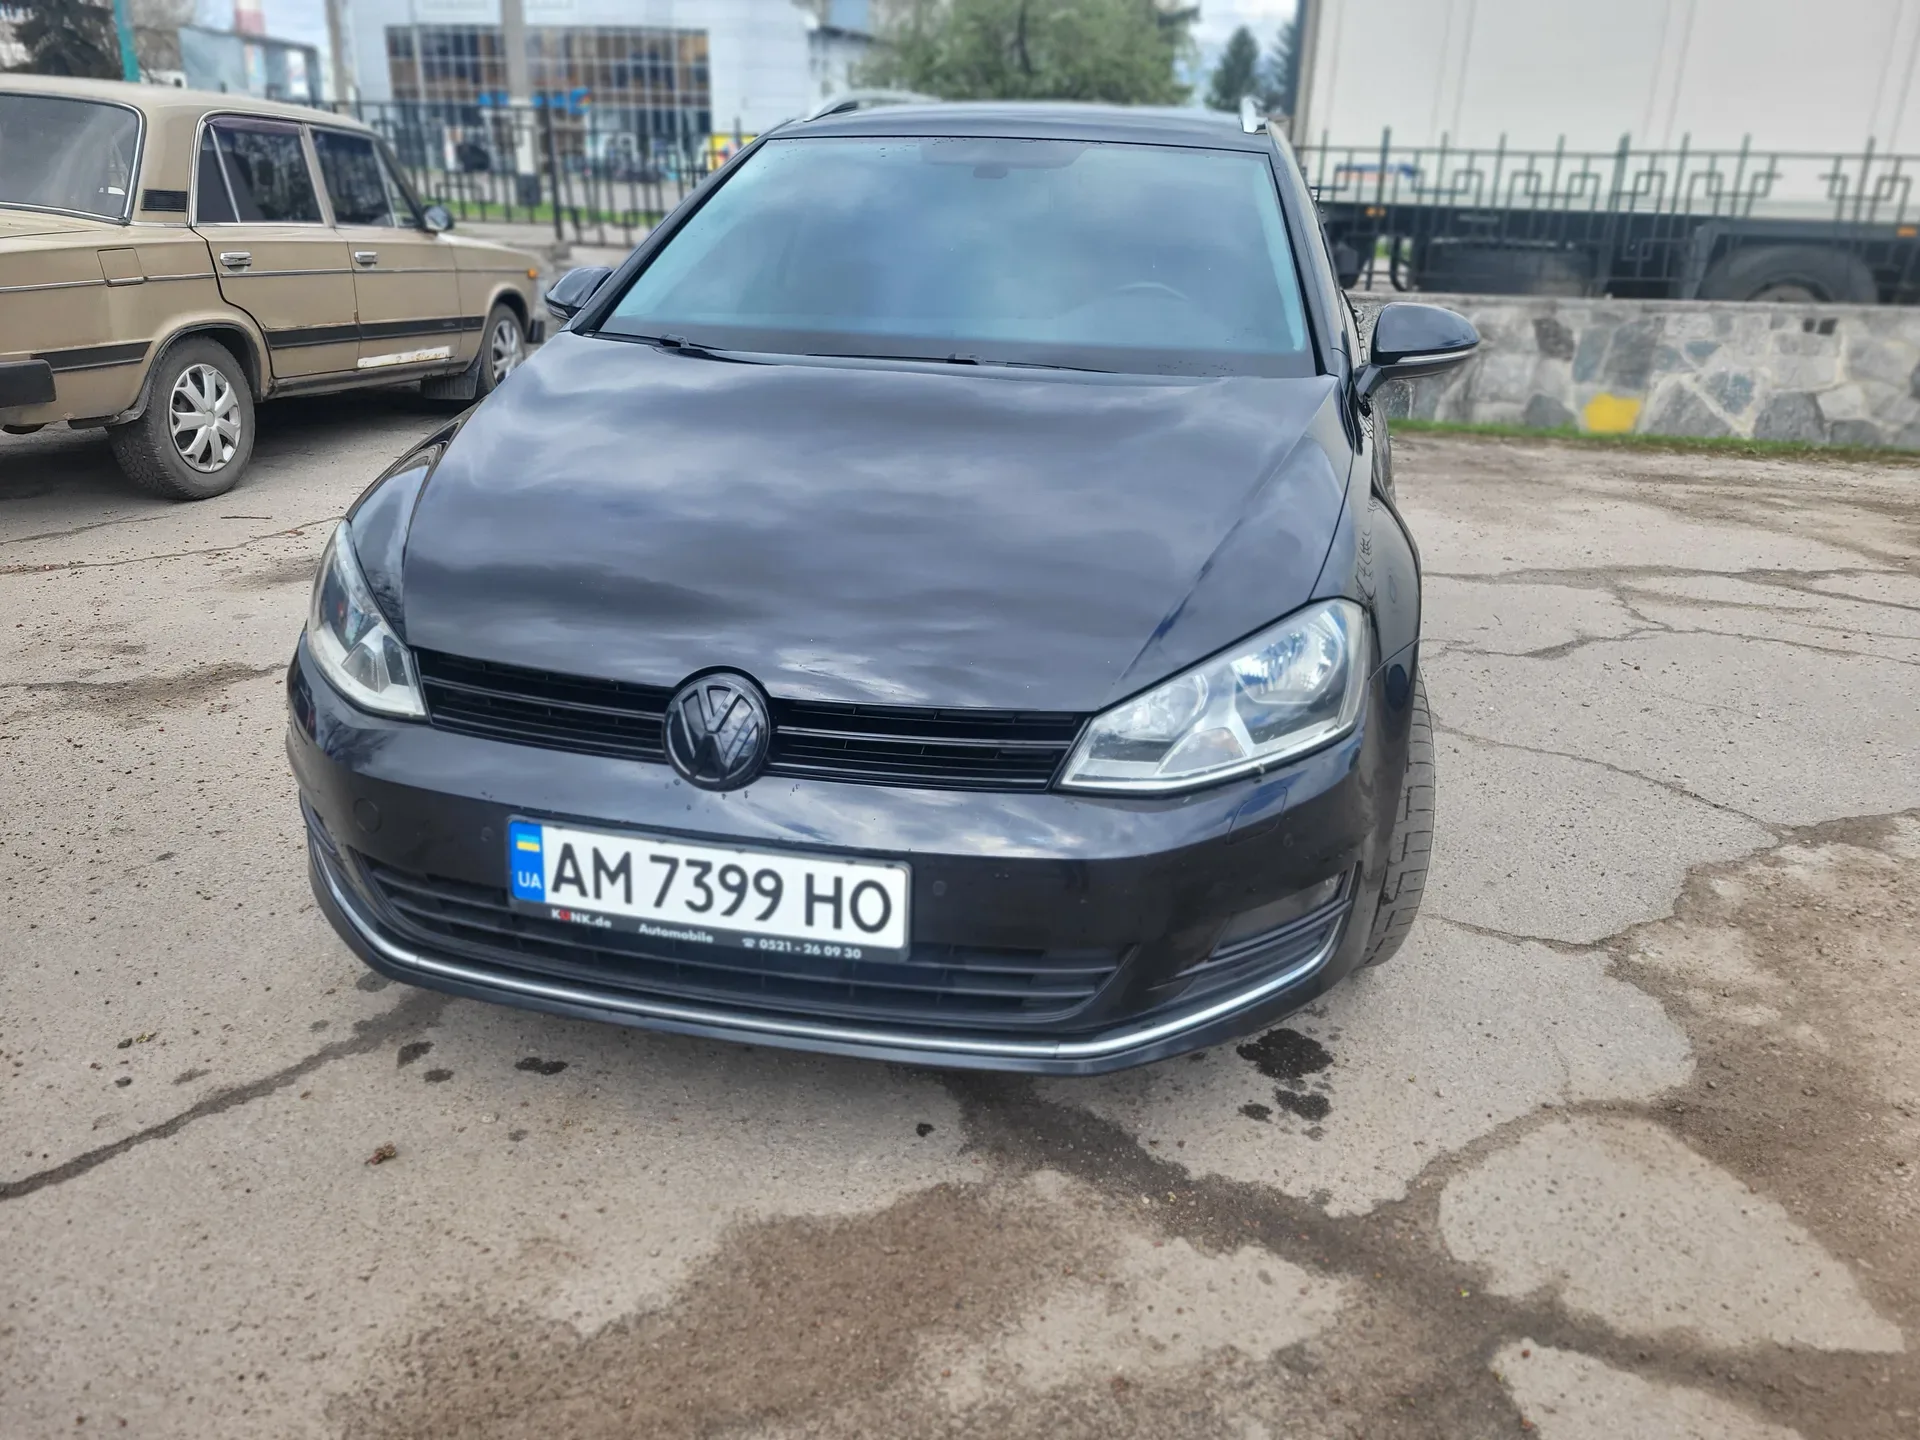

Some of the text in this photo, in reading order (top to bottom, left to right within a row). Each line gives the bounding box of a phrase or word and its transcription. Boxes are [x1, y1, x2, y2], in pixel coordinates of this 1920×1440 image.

[518, 871, 542, 890] UA
[551, 842, 892, 934] AM 7399 HO
[638, 923, 714, 944] Automobile
[759, 938, 792, 953] 0521
[803, 943, 821, 956] 26
[823, 945, 842, 957] 09
[843, 947, 862, 960] 30
